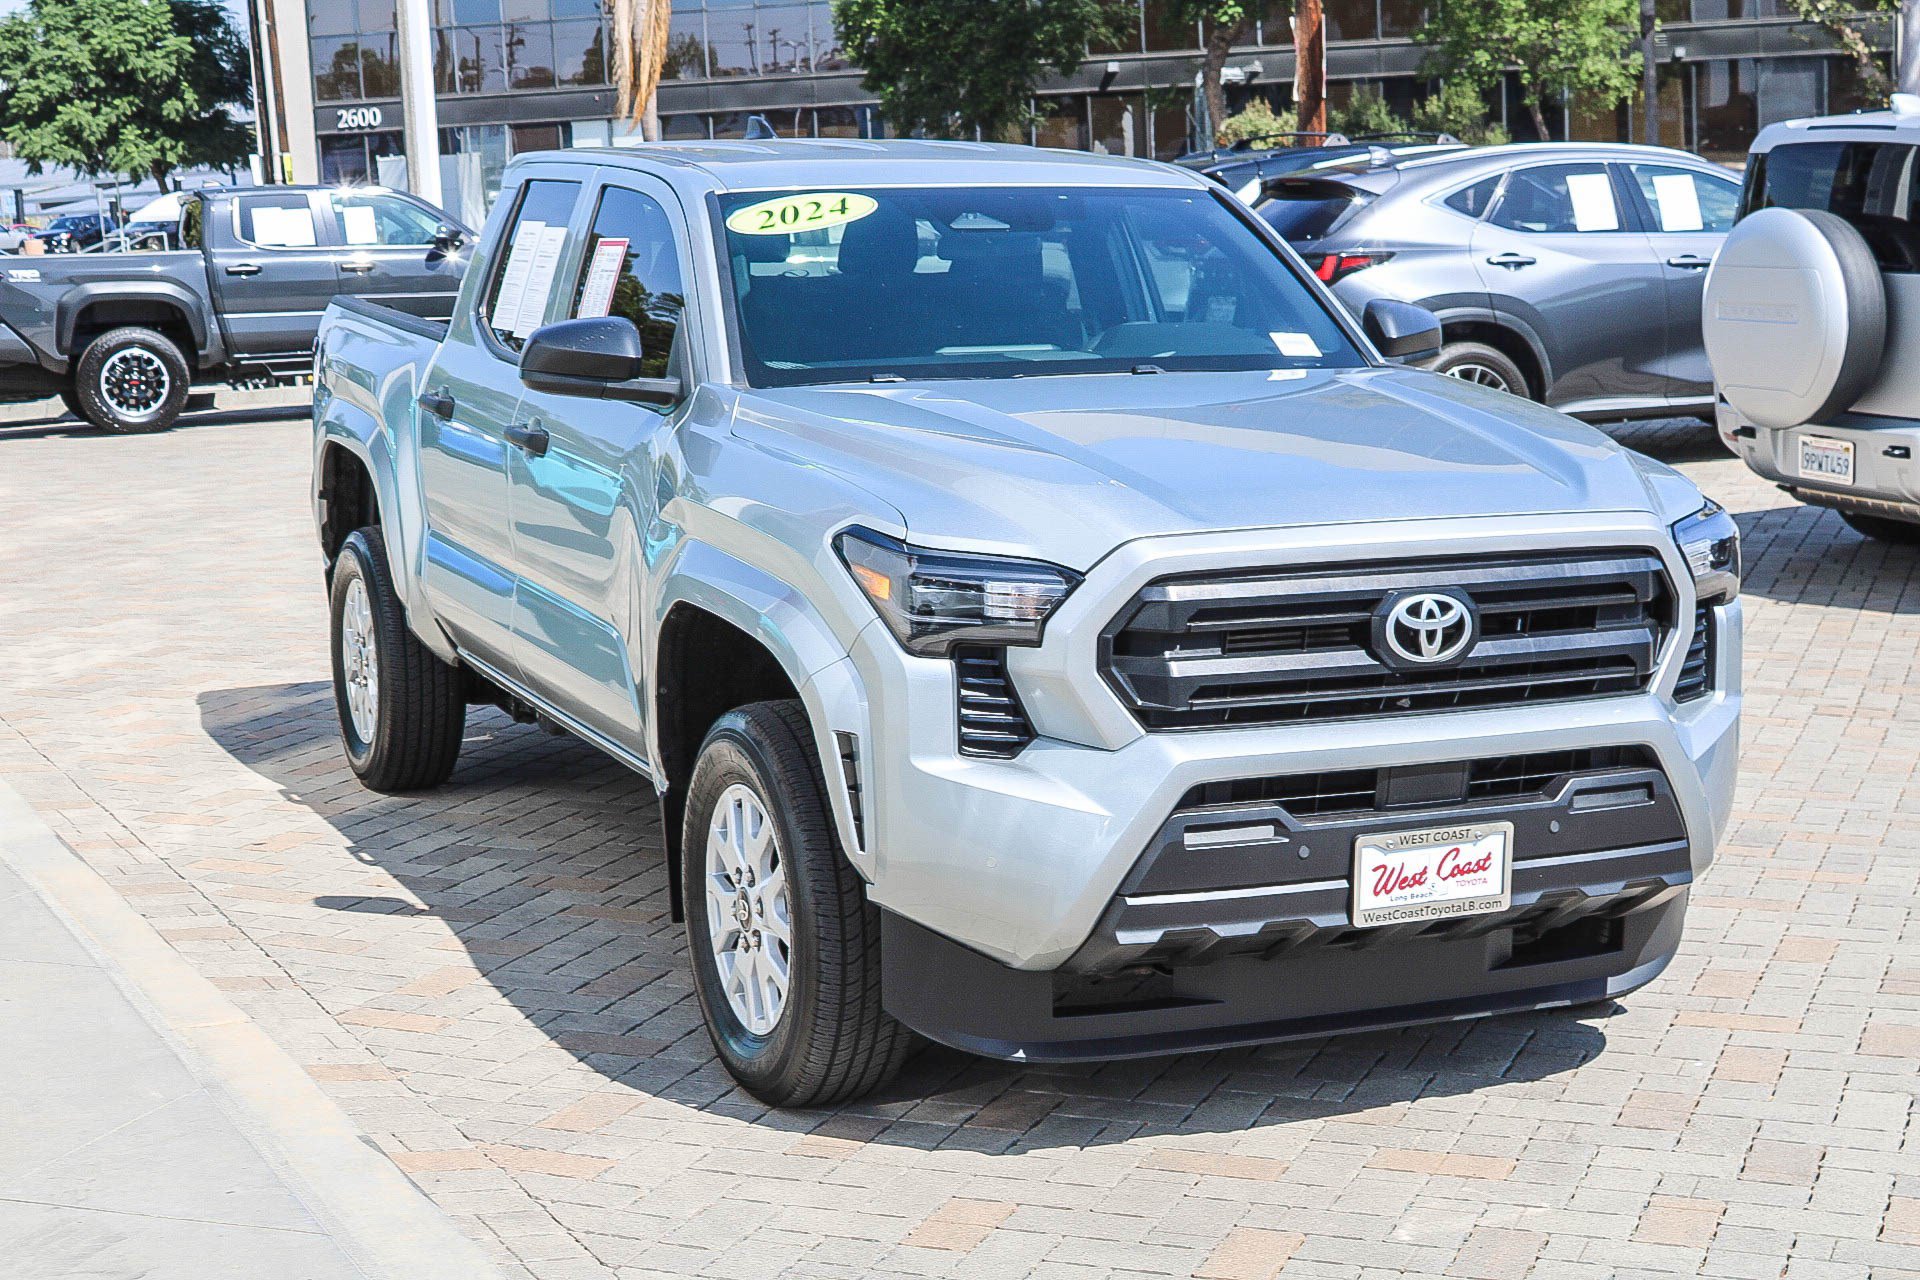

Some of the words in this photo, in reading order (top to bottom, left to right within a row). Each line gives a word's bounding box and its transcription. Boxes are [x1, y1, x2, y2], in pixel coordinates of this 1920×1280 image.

[336, 106, 382, 128] 2600
[757, 197, 849, 230] 2024
[1399, 833, 1431, 845] WEST
[1433, 829, 1472, 842] COAST
[1371, 862, 1428, 897] West
[1436, 847, 1492, 881] Coast
[1455, 878, 1488, 887] TOYOTA
[1390, 894, 1408, 902] Long
[1410, 892, 1433, 900] Beach
[1363, 900, 1502, 923] WestCoastToyotaLB.com
